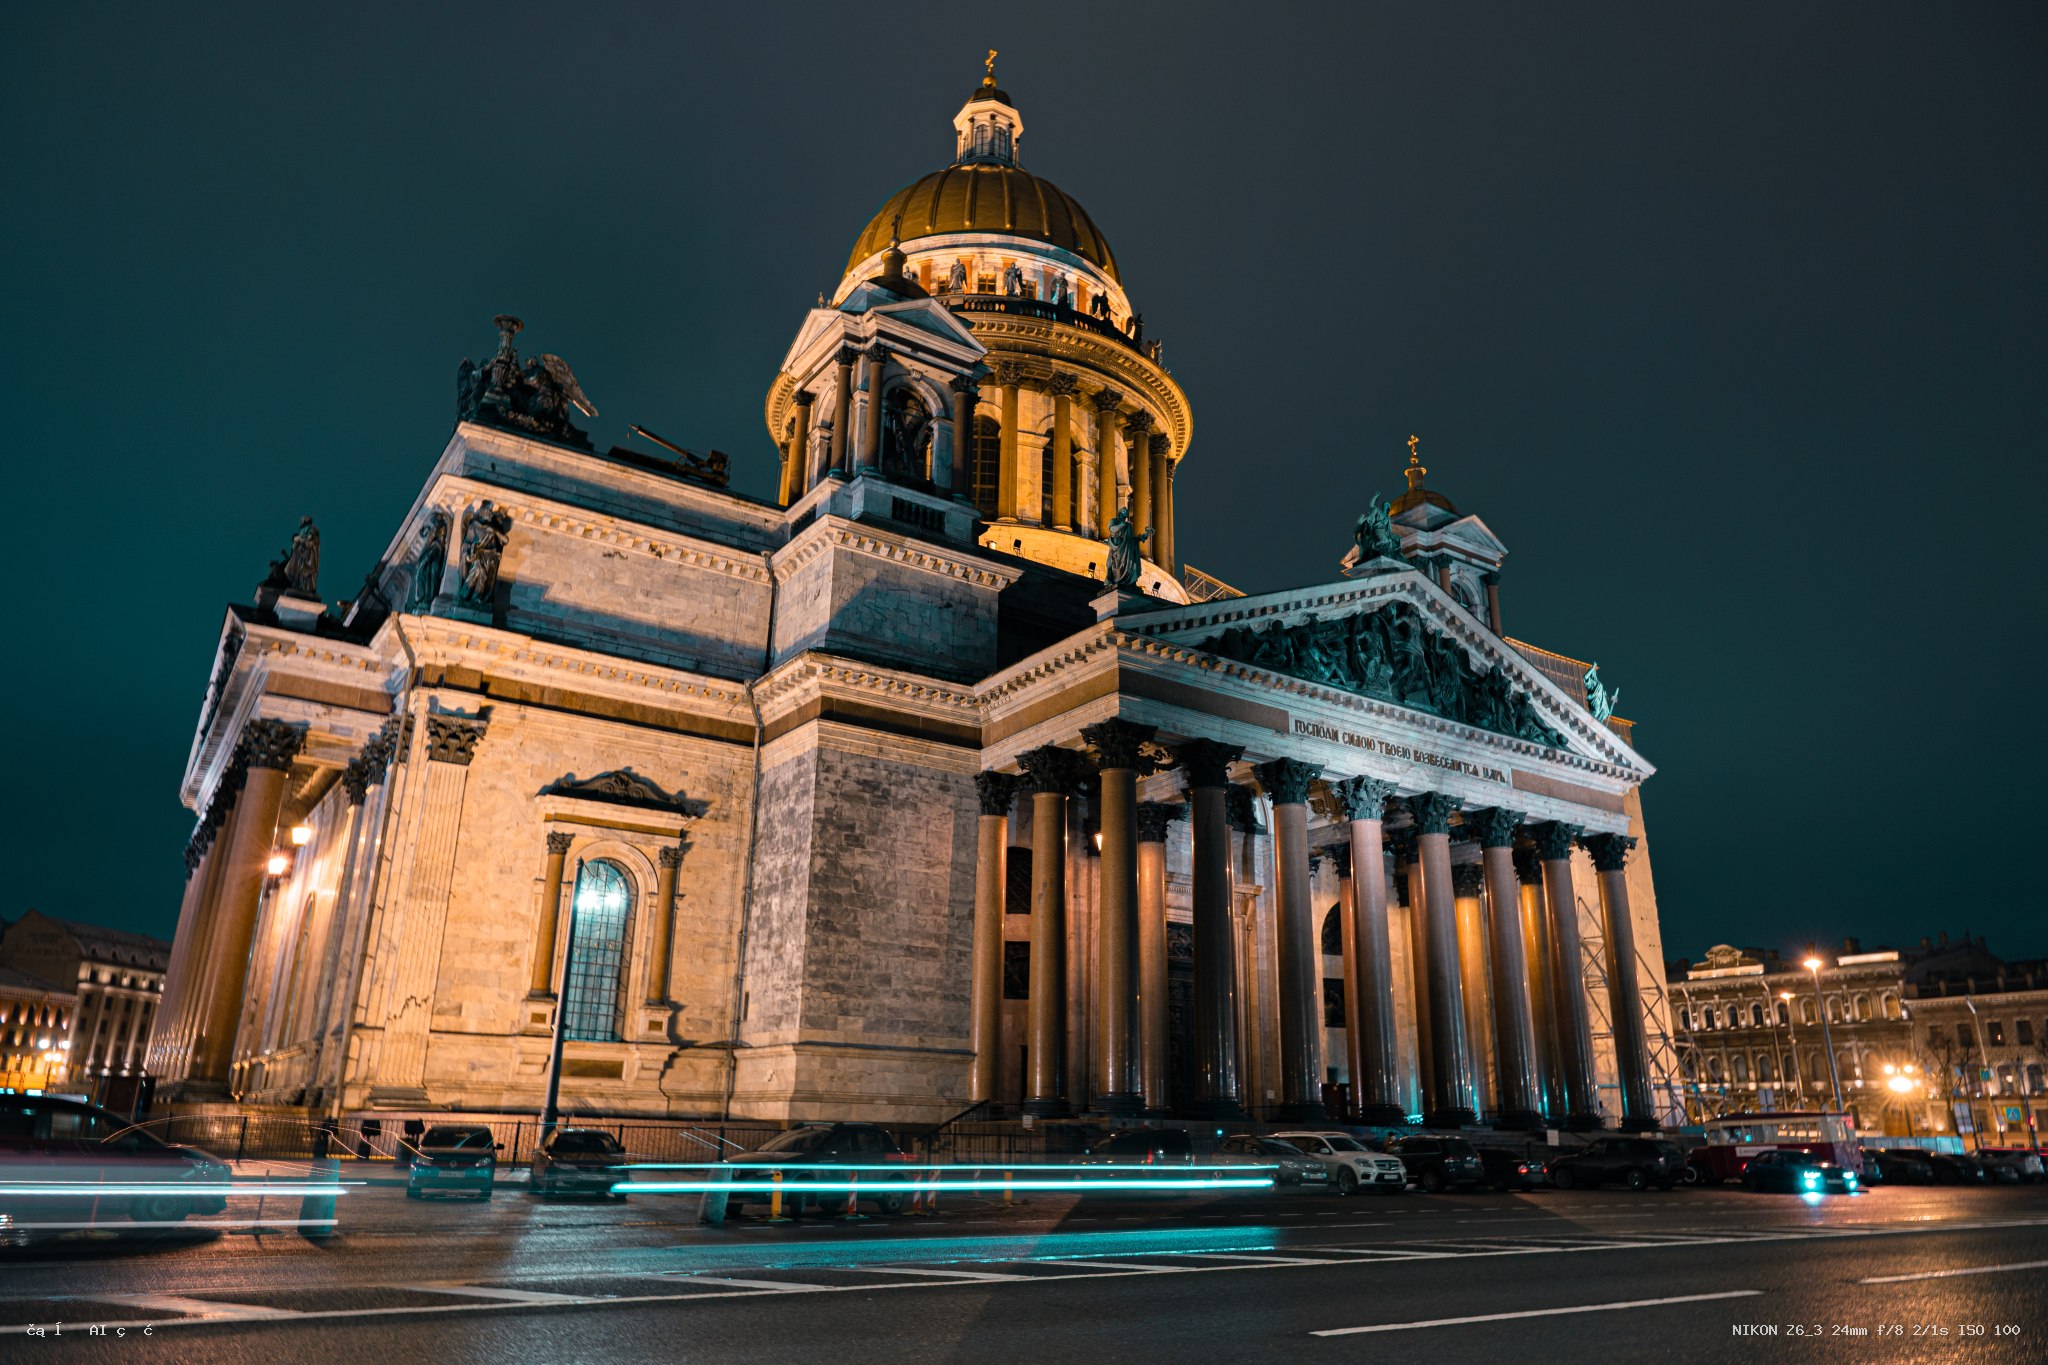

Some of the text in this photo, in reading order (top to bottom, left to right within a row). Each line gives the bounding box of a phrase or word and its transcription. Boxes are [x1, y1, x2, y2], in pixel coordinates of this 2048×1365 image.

[1294, 719, 1339, 742] ГОСПОДИ
[1342, 731, 1376, 751] СИЛОЮ
[1378, 740, 1411, 760] ТВОЕЮ
